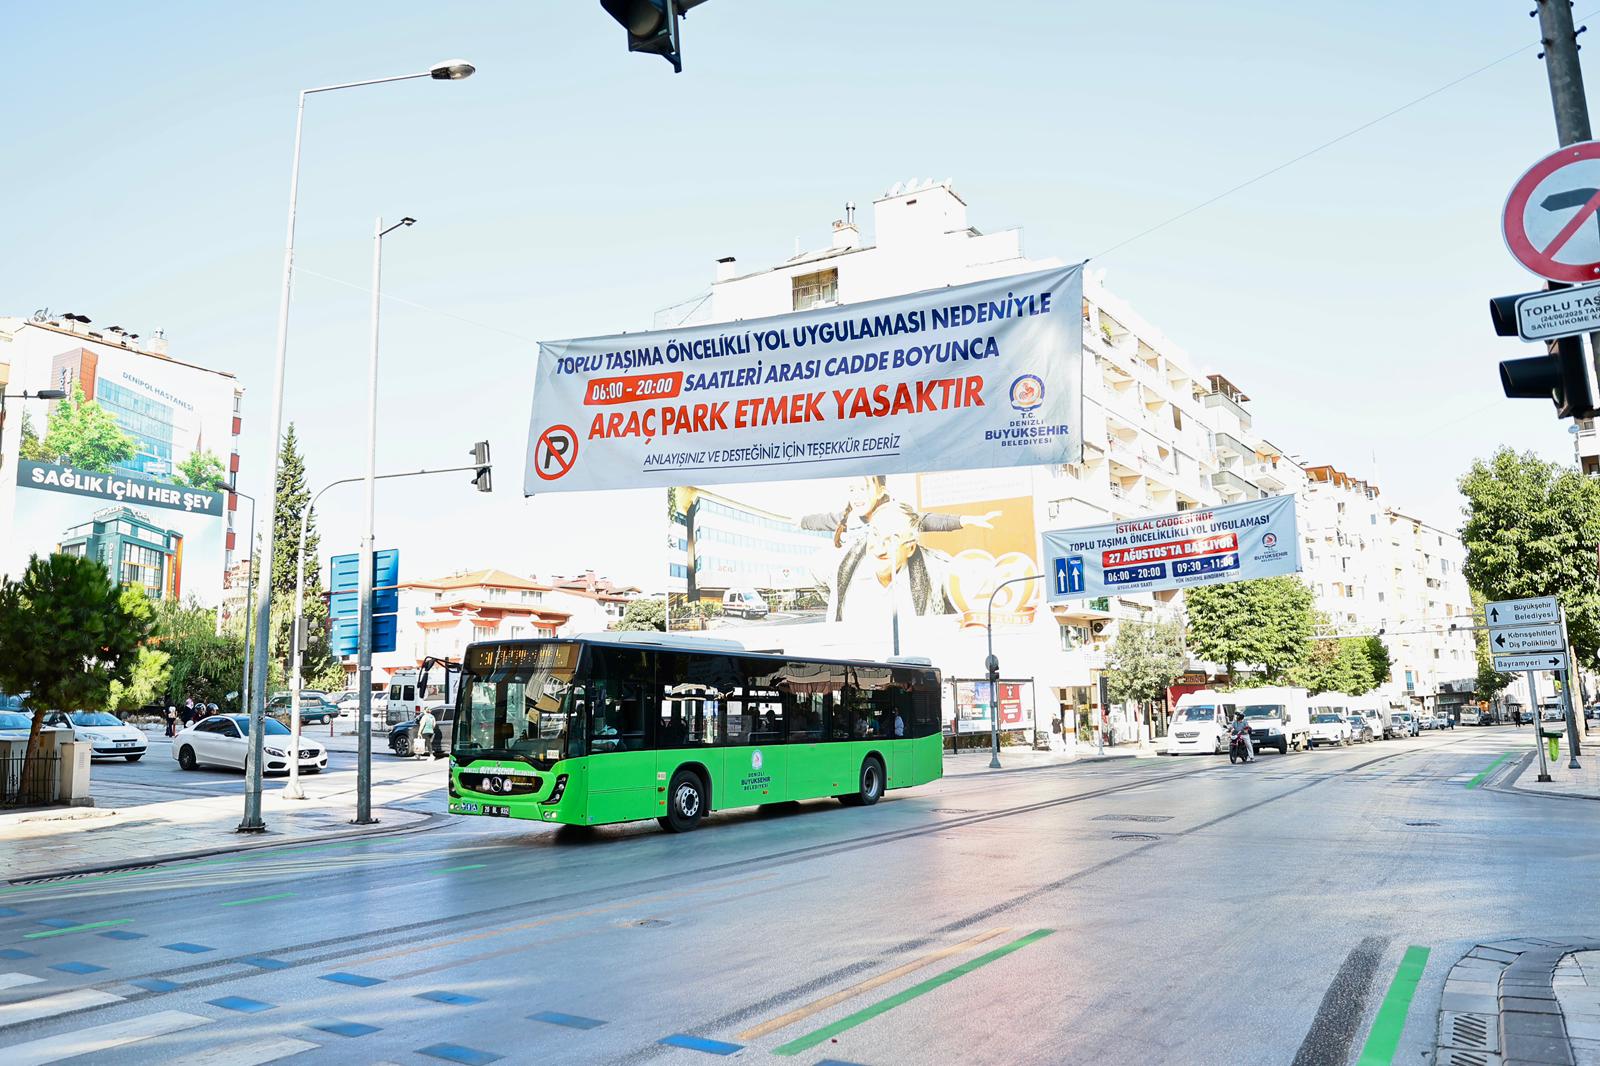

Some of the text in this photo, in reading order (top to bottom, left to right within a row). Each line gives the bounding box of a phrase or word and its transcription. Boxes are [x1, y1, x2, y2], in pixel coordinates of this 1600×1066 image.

[1524, 301, 1571, 317] TOPLU
[1559, 315, 1590, 326] UKOME
[556, 292, 1052, 375] TOPLU TAŞIMA ÖNCELİKLİ YOL UYGULAMASI NEDENİYLE
[592, 380, 624, 401] 06:00
[636, 377, 674, 396] 20:00
[683, 360, 763, 392] SAATLERİ
[764, 360, 822, 385] ARASI
[824, 350, 889, 379] CADDE
[892, 336, 1000, 368] BOYUNCA
[588, 375, 986, 445] ARAÇ PARK ETMEK YASAKTIR
[644, 432, 900, 467] ANLAYIŞINIZ VE DESTEĞİNİZ İÇİN TEŞEKKÜR EDERİZ
[32, 467, 213, 511] SAĞLIK İÇİN HER ŞEY
[1070, 542, 1095, 552] TOPLU
[1097, 536, 1128, 549] TAŞIMA
[1191, 524, 1208, 535] YOL
[1210, 515, 1270, 533] UYGULAMASI
[1115, 521, 1153, 535] İSTİKLAL
[1109, 553, 1120, 564] 27
[1124, 547, 1182, 562] AĞUSTOS'TA
[1107, 572, 1130, 582] 06:00
[1138, 566, 1161, 579] 20:00
[1177, 562, 1201, 574] 09:30
[1514, 611, 1554, 621] Belediyesi
[1498, 659, 1541, 668] Bayramyeri
